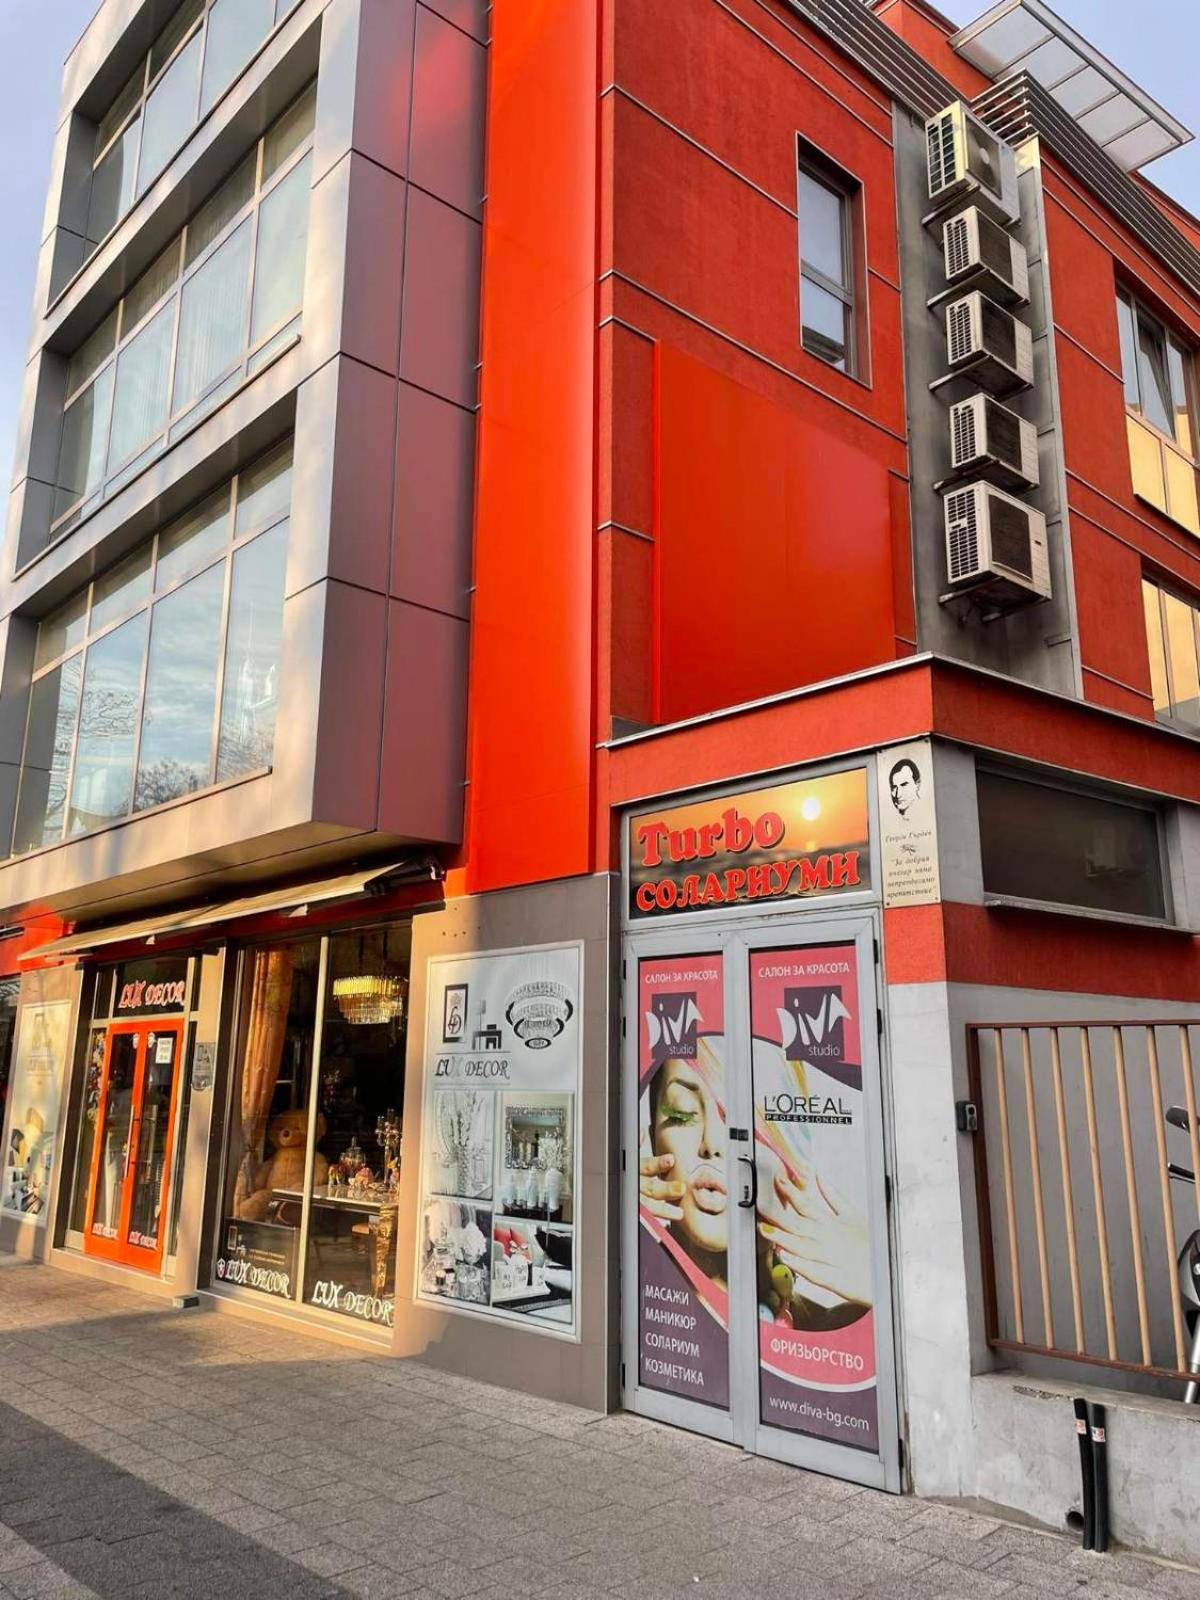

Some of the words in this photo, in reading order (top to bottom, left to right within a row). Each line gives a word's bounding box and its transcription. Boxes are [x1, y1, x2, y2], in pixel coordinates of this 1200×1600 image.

[637, 807, 785, 868] Turbo
[636, 850, 861, 912] СОЛАРИУМИ
[645, 973, 671, 984] САЛОН
[672, 972, 683, 982] ЗА
[683, 970, 719, 982] КРАСОТА
[758, 966, 791, 978] САЛОН
[792, 965, 805, 976] ЗА
[806, 962, 850, 975] КРАСОТА
[118, 980, 146, 1009] LUX
[145, 980, 185, 1006] DECOR
[669, 1043, 694, 1056] studio
[808, 1043, 841, 1057] studio
[464, 1058, 511, 1080] DECOR
[764, 1093, 852, 1115] L'ORÉAL
[764, 1113, 853, 1125] PROFESSIONNEL
[225, 1258, 251, 1285] LUX
[250, 1265, 291, 1299] DECOR
[311, 1279, 344, 1308] LUX
[343, 1290, 394, 1328] DECOR
[645, 1284, 690, 1306] МАСАЖИ
[645, 1306, 697, 1331] МАНИКЮР
[645, 1332, 700, 1358] СОЛАРИУМ
[770, 1337, 865, 1371] ФРИЗЬОРСТВО
[645, 1357, 705, 1386] КОЗМЕТИКА
[769, 1396, 870, 1431] www.diva-bg.com
